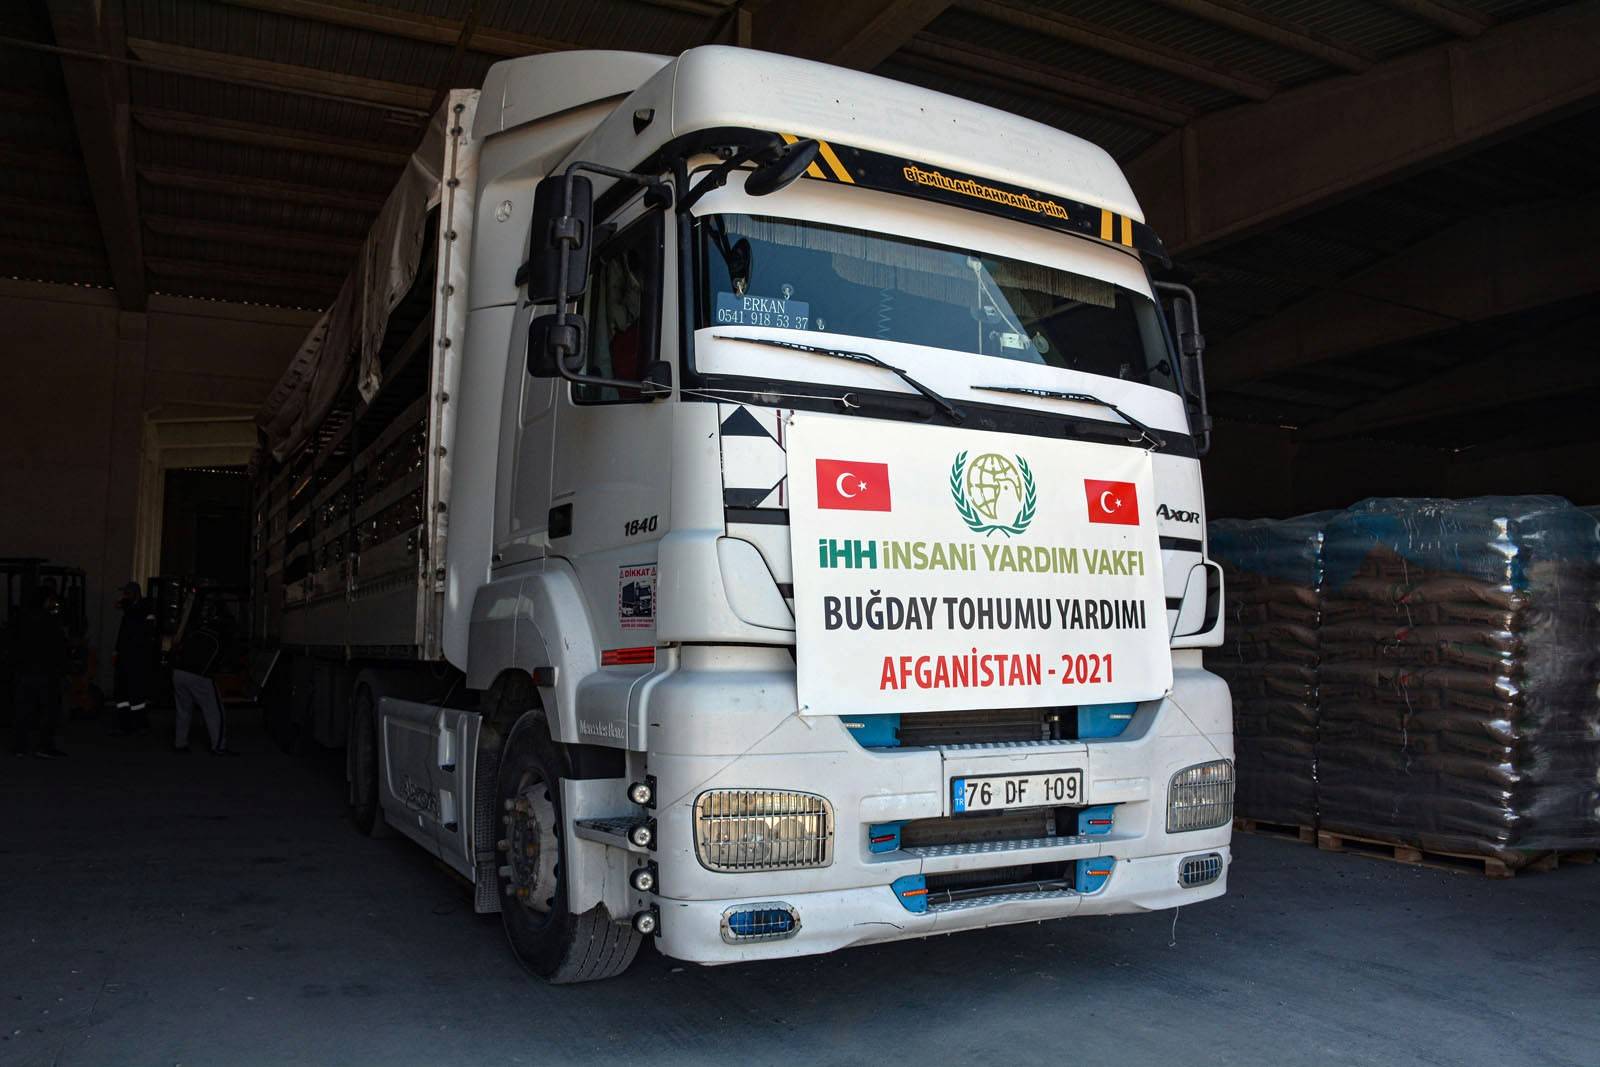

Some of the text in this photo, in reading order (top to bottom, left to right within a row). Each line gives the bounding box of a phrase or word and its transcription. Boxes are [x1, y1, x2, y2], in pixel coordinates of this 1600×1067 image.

[743, 297, 785, 314] ERKAN
[718, 309, 809, 330] 0541 918 53 37
[624, 514, 657, 537] 1840
[624, 568, 650, 577] DİKKAT
[981, 544, 1079, 574] YARDIM
[1083, 548, 1145, 576] VAKFI
[823, 589, 1147, 631] BUĞDAY TOHUMU YARDIMI
[880, 647, 1042, 690] AFGANİSTAN
[1061, 653, 1112, 685] 2021
[955, 776, 1077, 807] TR 76 DF 109
